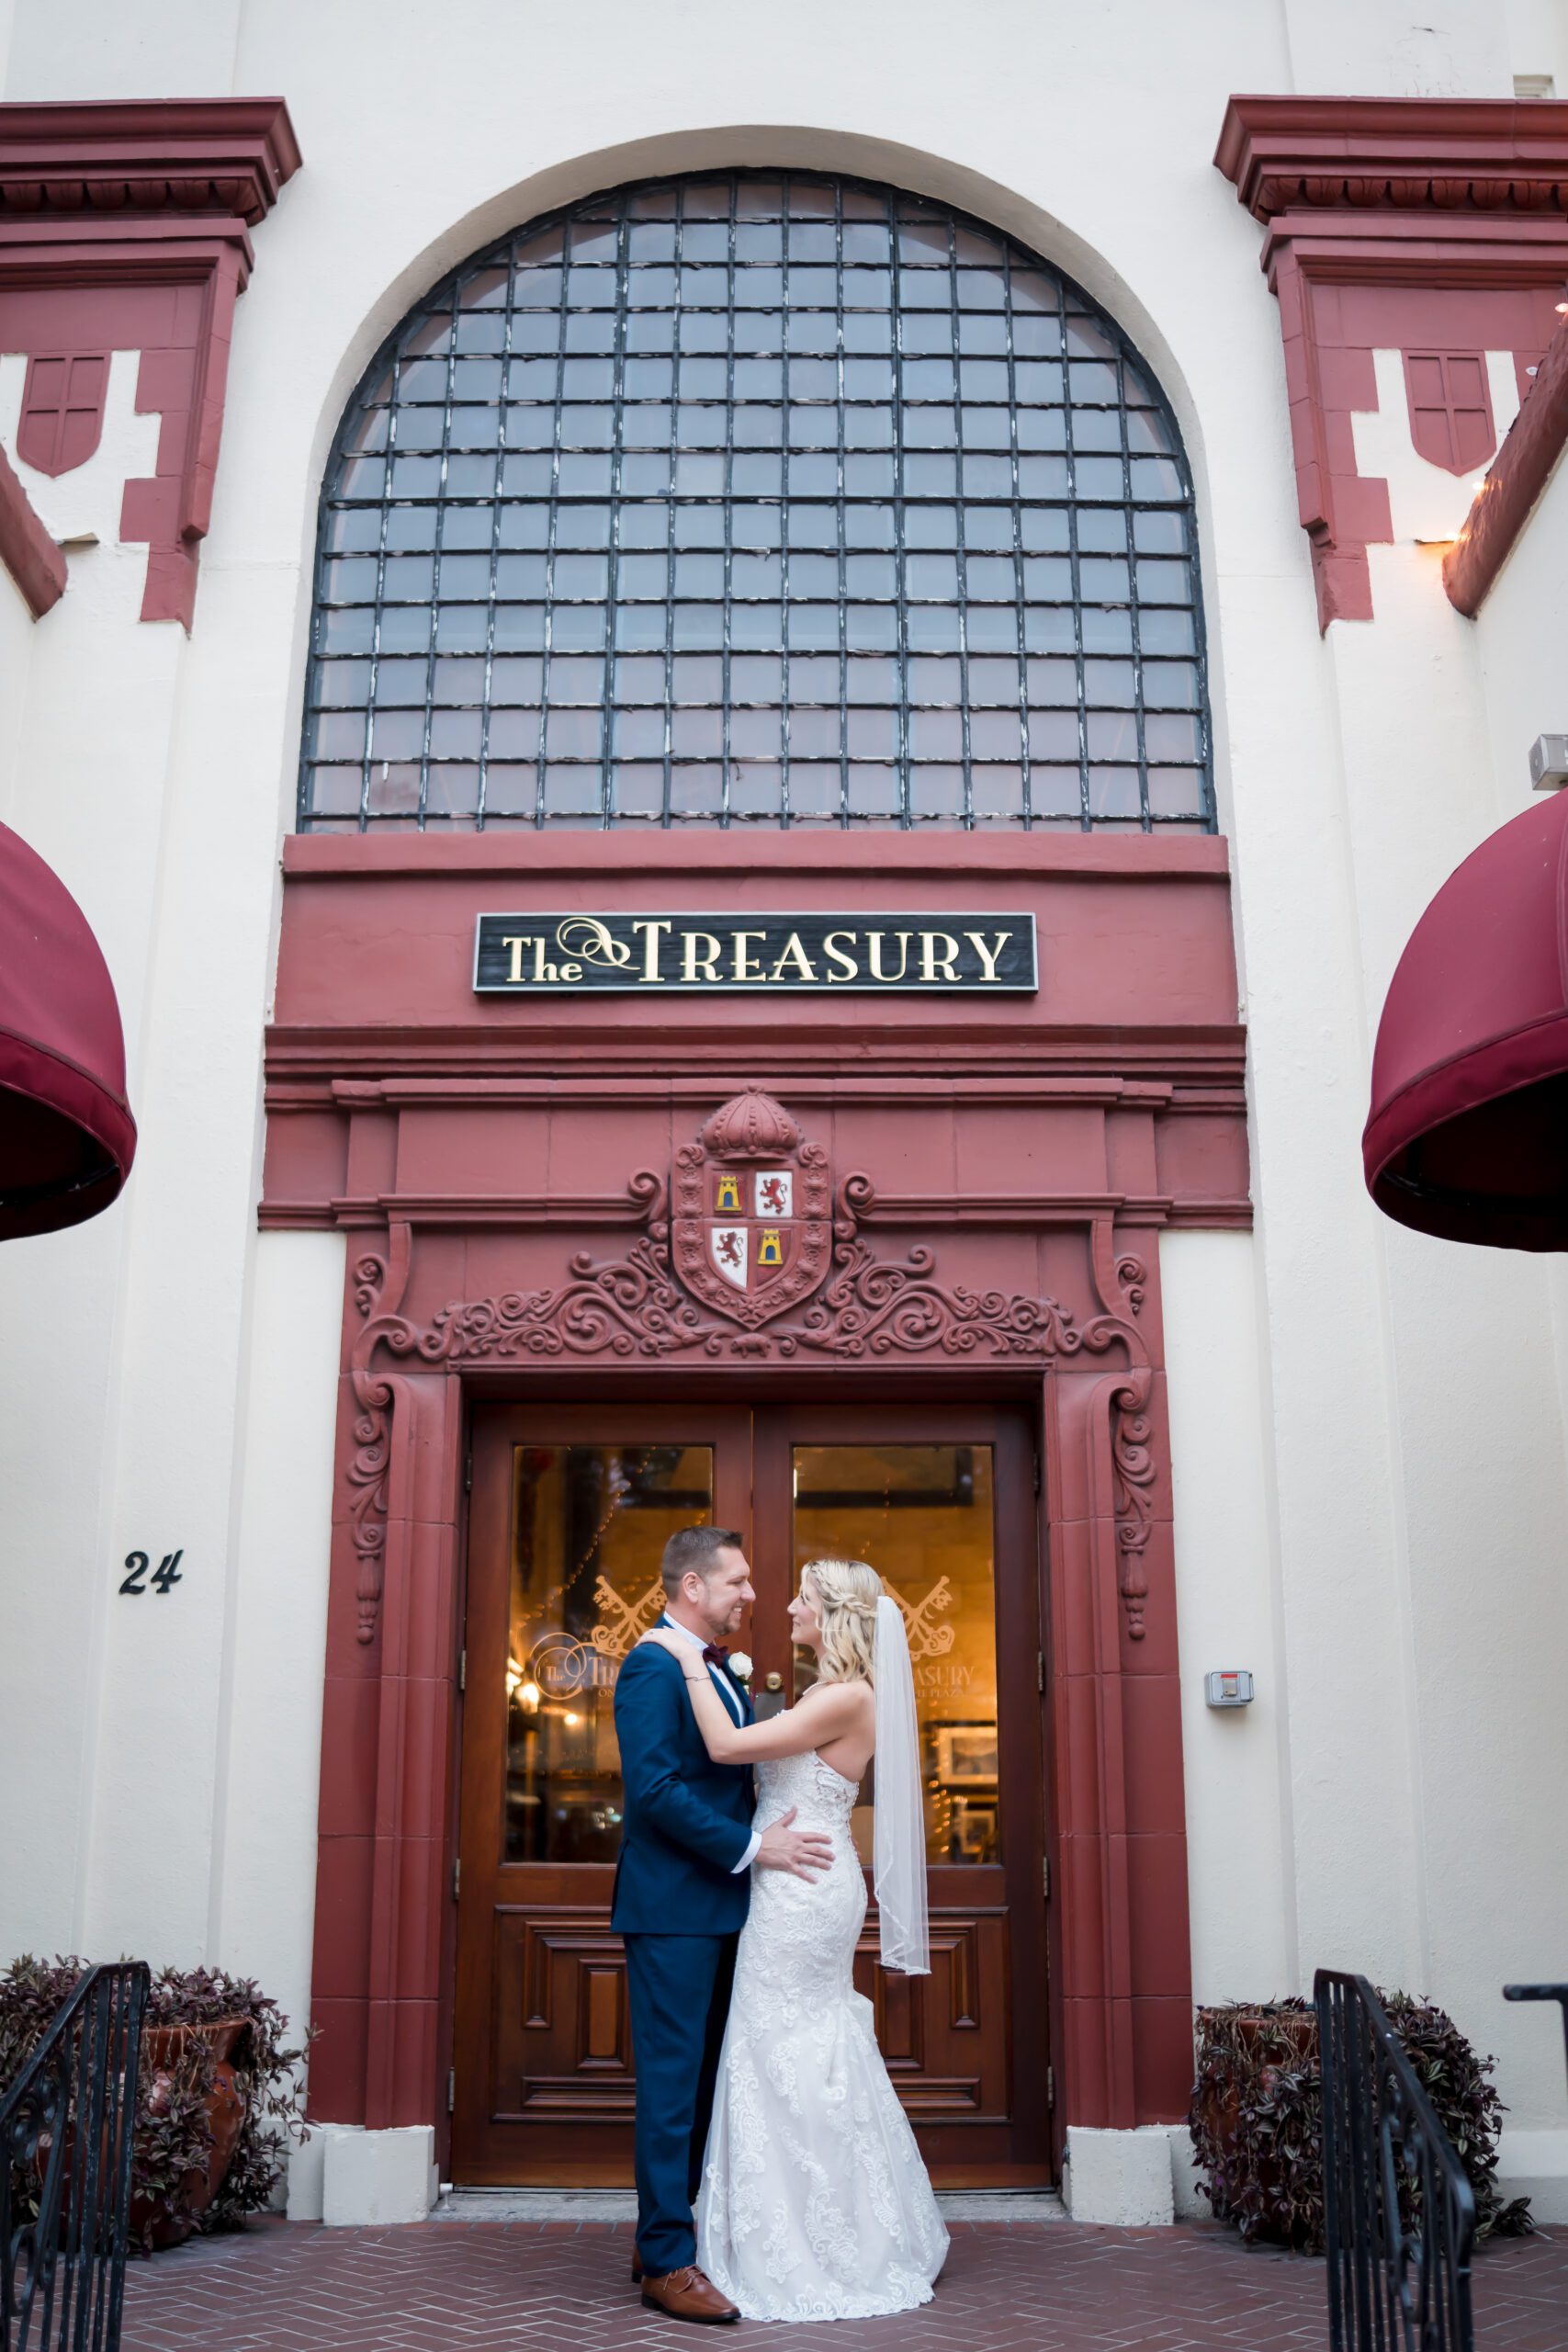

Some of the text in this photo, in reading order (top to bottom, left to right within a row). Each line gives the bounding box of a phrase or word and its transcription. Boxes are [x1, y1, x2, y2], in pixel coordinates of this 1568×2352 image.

[502, 921, 1013, 983] The TREASURY
[118, 1549, 184, 1596] 24
[914, 1666, 976, 1686] ASURY
